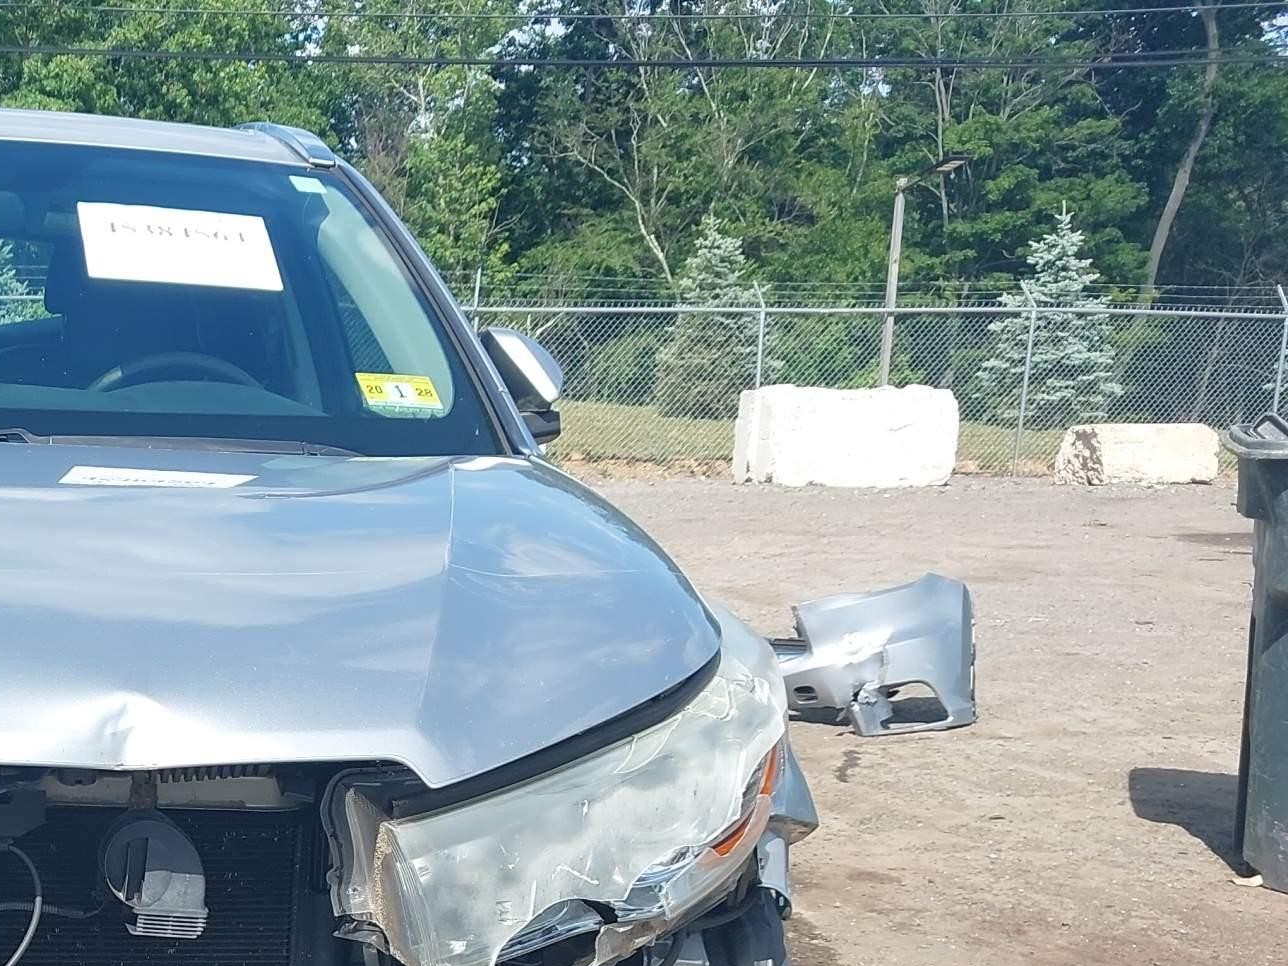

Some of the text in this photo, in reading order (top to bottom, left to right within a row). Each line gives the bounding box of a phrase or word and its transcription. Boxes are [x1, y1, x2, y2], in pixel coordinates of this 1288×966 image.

[366, 385, 433, 398] 20 1 28
